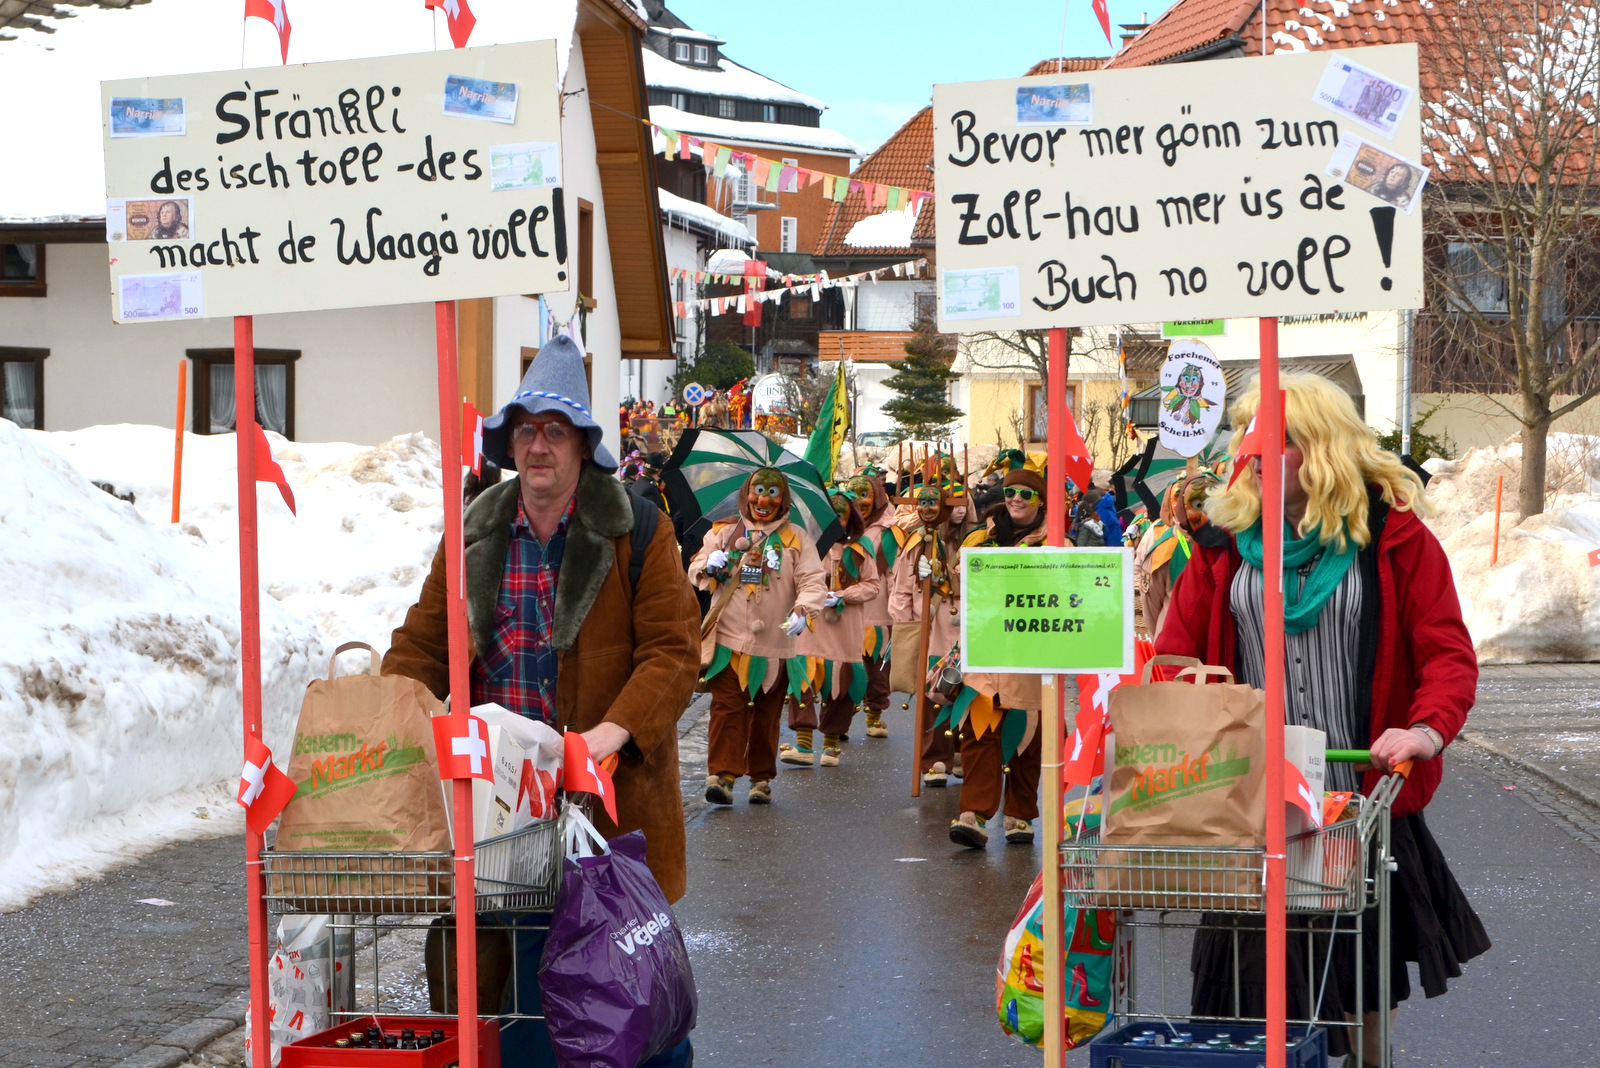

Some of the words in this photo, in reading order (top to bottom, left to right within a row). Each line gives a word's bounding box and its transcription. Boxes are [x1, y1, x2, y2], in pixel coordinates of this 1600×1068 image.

[1376, 79, 1403, 103] 500
[948, 110, 1067, 168] Bevor
[1079, 125, 1146, 159] mer
[1156, 105, 1242, 167] gönn
[1255, 119, 1340, 151] zum
[150, 157, 211, 193] des
[218, 155, 290, 191] isch
[296, 142, 384, 186] toll
[1156, 190, 1226, 229] mer
[149, 226, 262, 269] macht
[278, 220, 316, 265] de
[1031, 254, 1138, 312] Buch
[1159, 266, 1208, 298] no
[184, 307, 199, 315] 500
[1002, 302, 1016, 310] 100
[1167, 351, 1222, 370] Forchemer
[1094, 576, 1111, 588] 22
[1005, 593, 1060, 609] PETER
[1069, 593, 1084, 609] &
[1004, 618, 1085, 633] NORBERT
[311, 739, 387, 790] Markt
[1131, 751, 1210, 801] Markt
